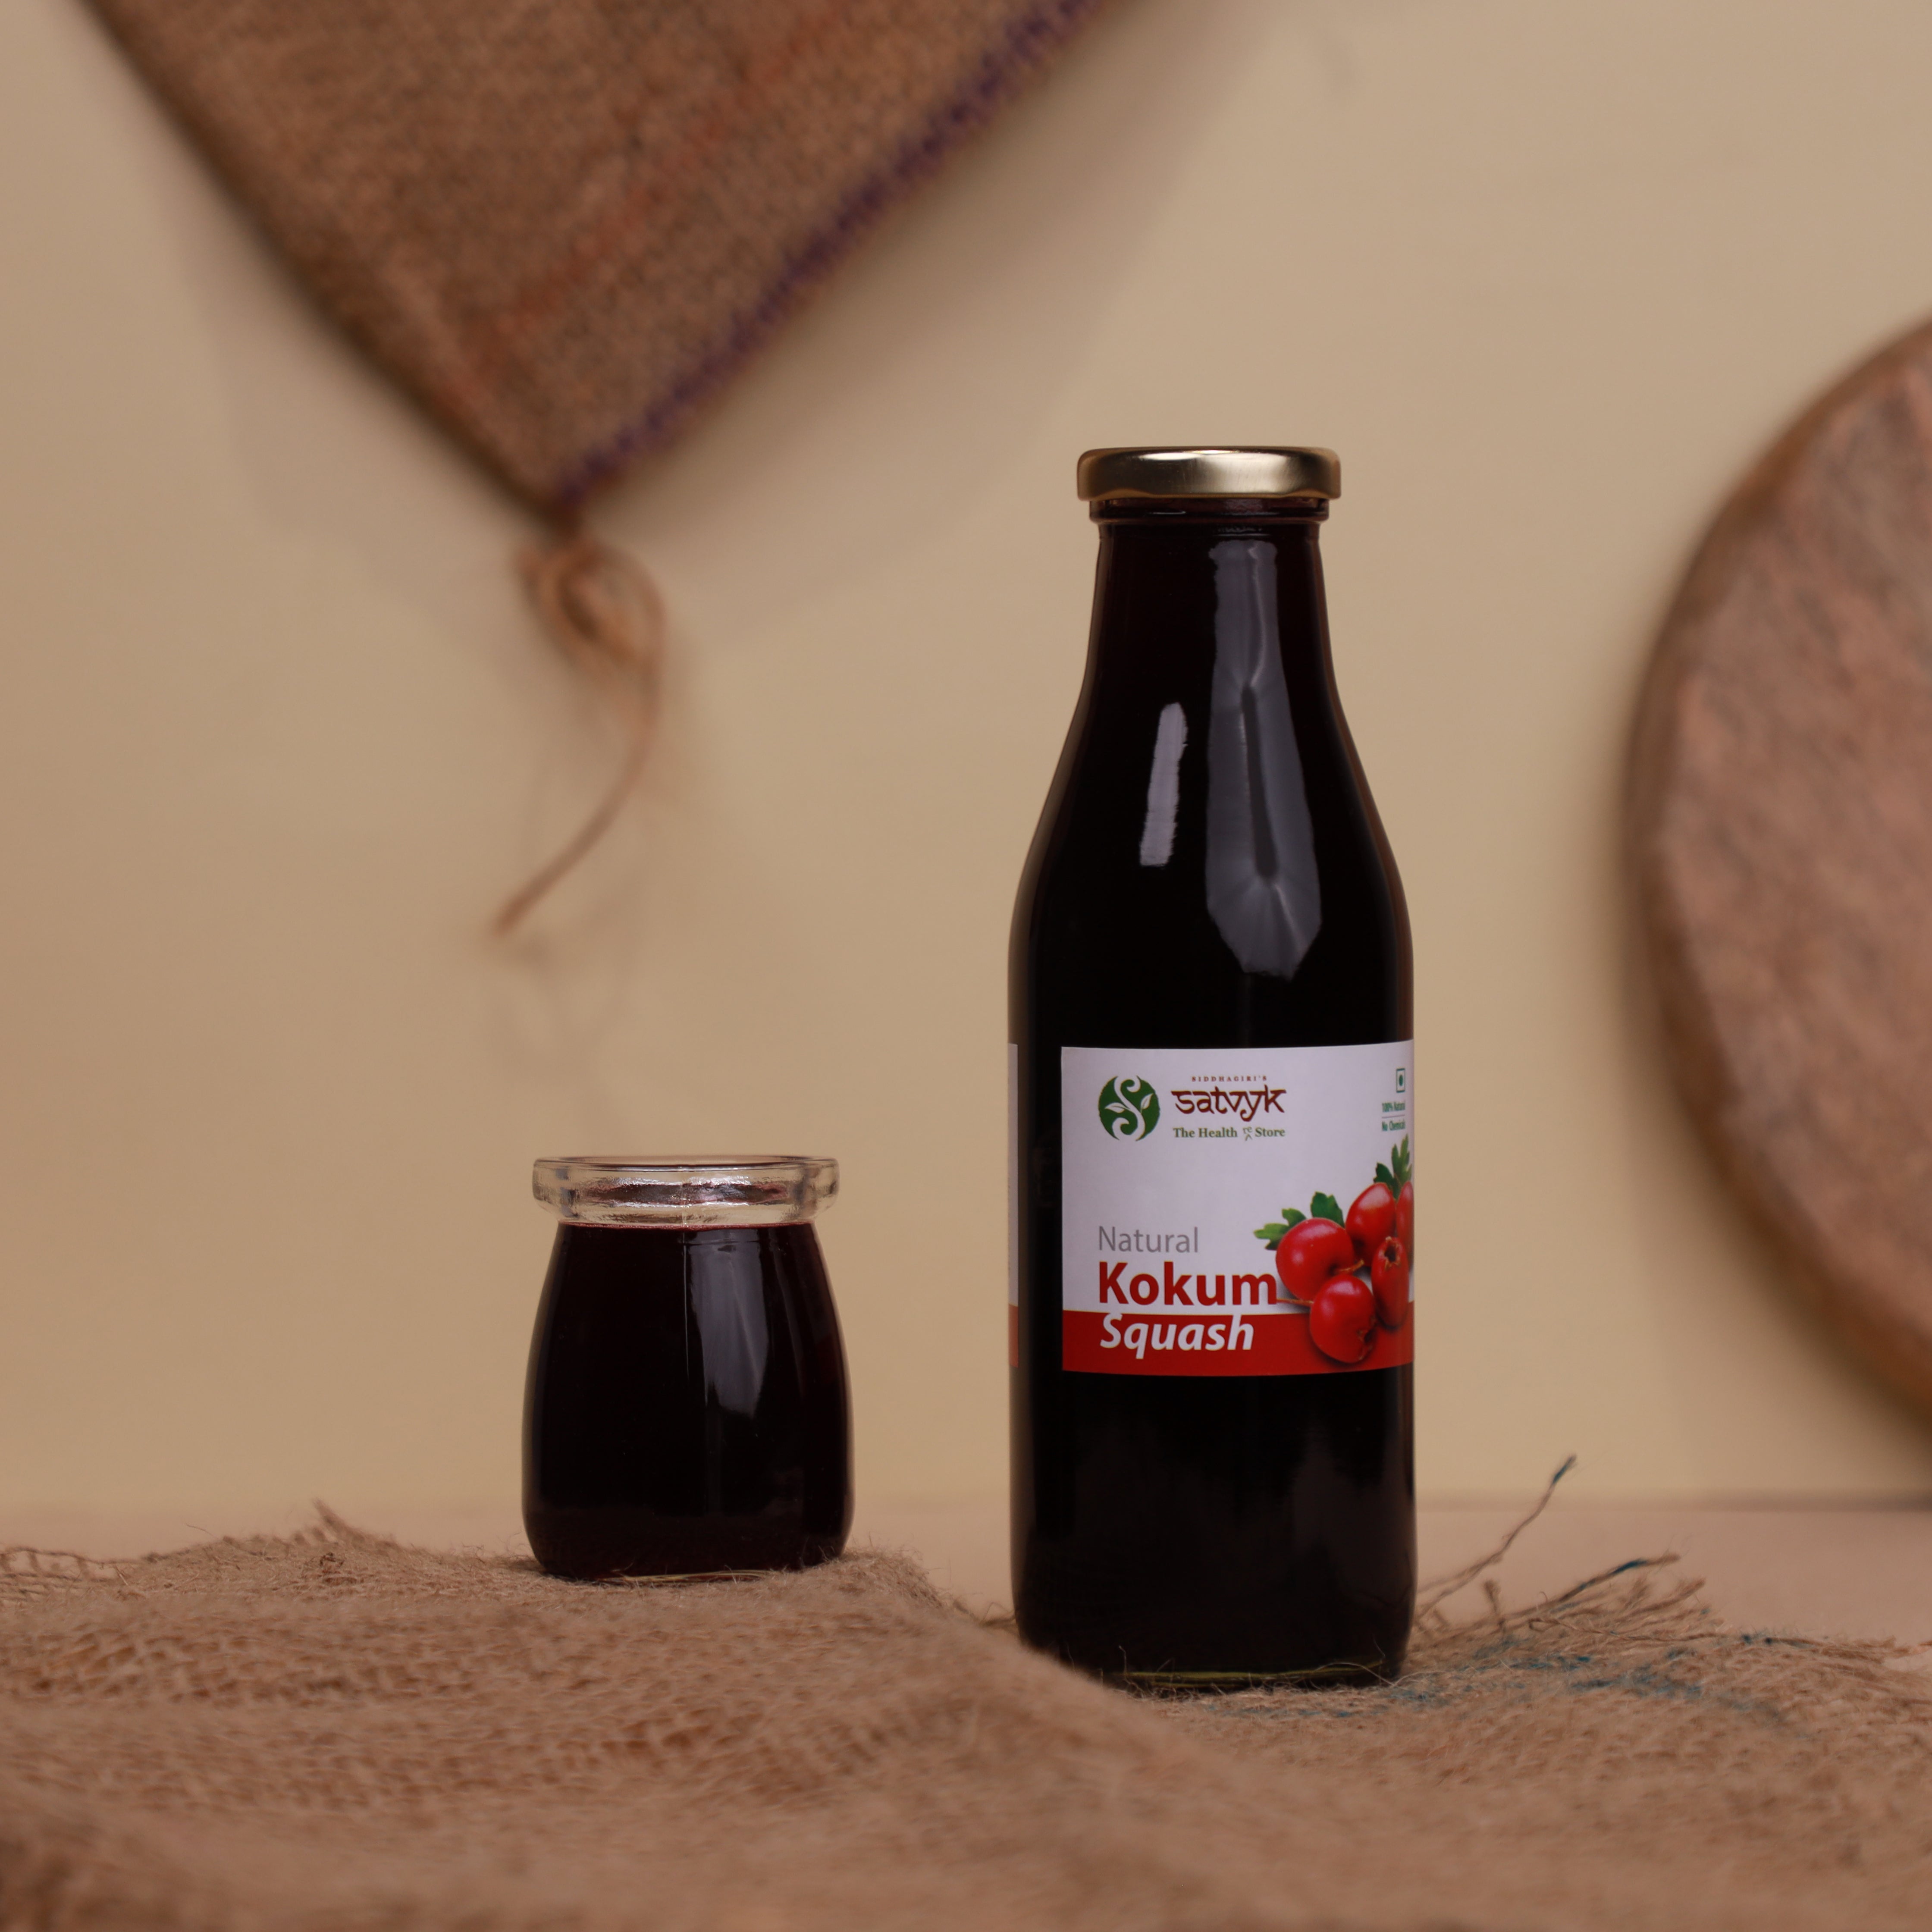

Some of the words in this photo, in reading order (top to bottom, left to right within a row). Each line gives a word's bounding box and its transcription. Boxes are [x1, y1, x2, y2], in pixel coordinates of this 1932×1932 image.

[1171, 1084, 1287, 1122] satvyk
[1173, 1127, 1195, 1138] The
[1198, 1127, 1238, 1138] Health
[1255, 1127, 1286, 1137] Store
[1099, 1226, 1198, 1253] Natural
[1099, 1261, 1276, 1306] Kokum
[1100, 1313, 1254, 1359] Squash
